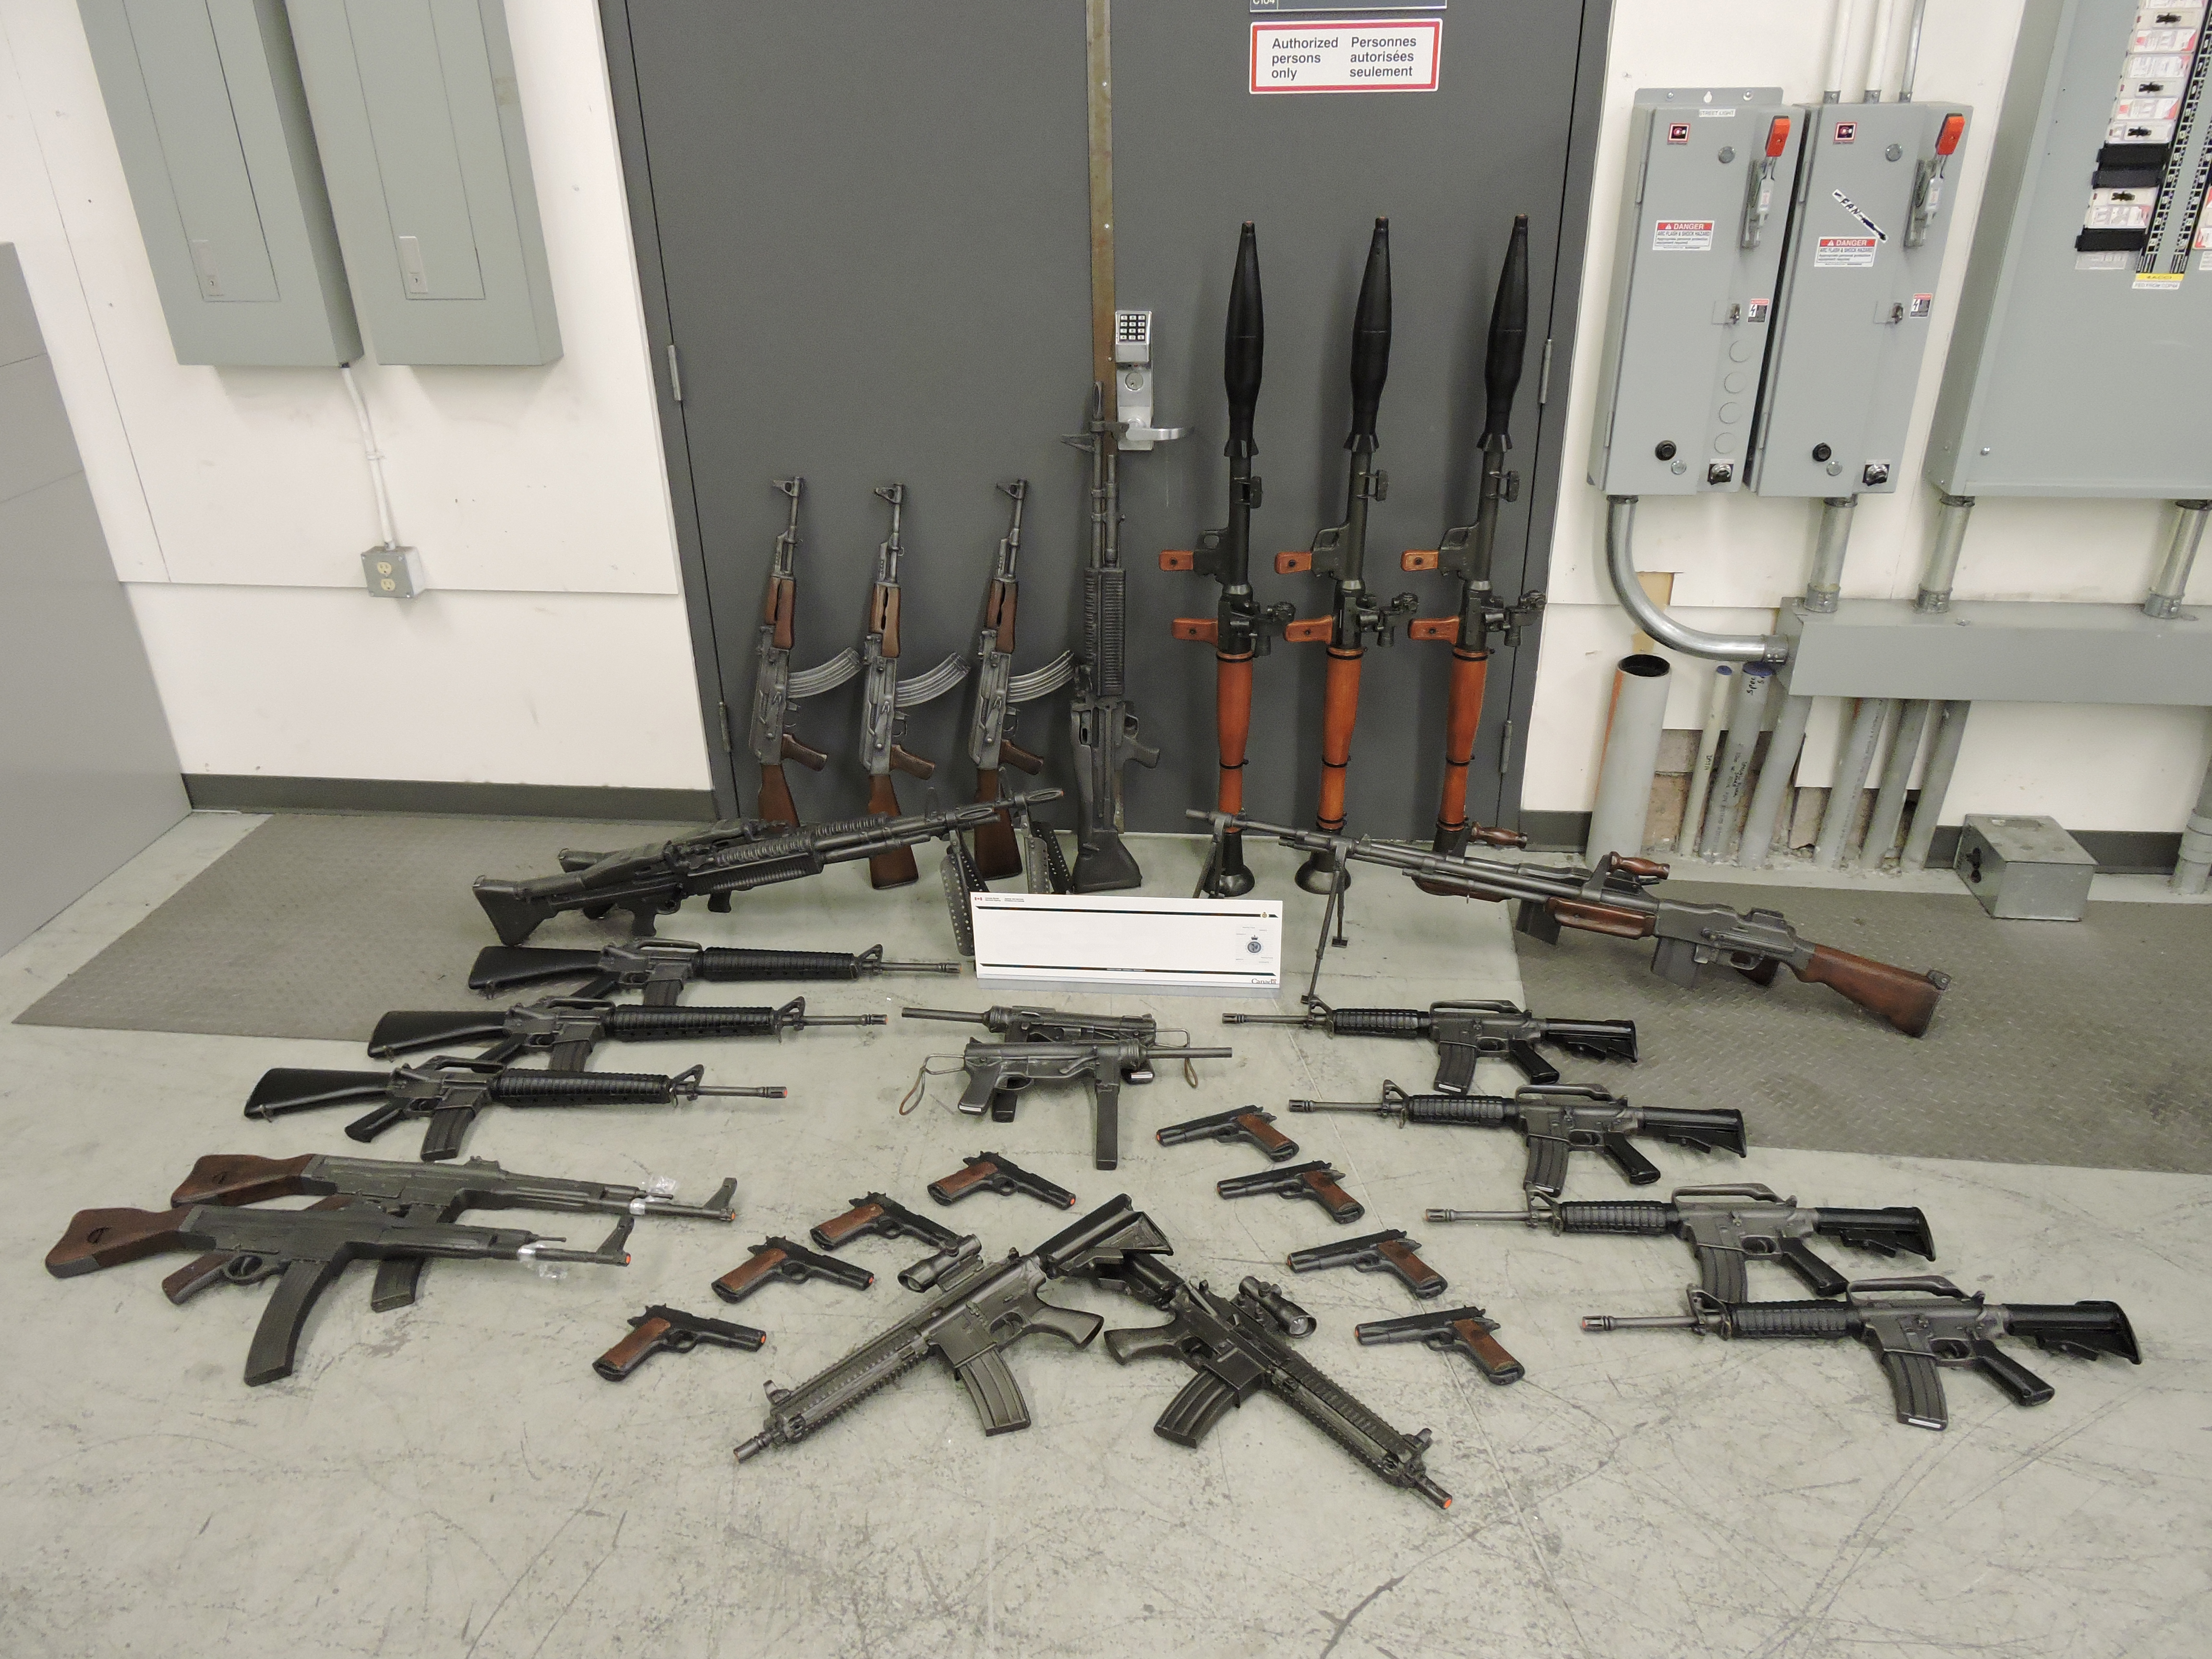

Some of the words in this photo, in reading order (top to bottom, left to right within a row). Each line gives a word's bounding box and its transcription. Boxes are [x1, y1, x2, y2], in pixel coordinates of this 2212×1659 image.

[1272, 37, 1338, 49] Authorized
[1351, 36, 1417, 48] Personnes
[1272, 54, 1321, 66] persons
[1350, 49, 1414, 63] autorisées
[1271, 68, 1297, 81] only
[1349, 65, 1413, 77] seulement
